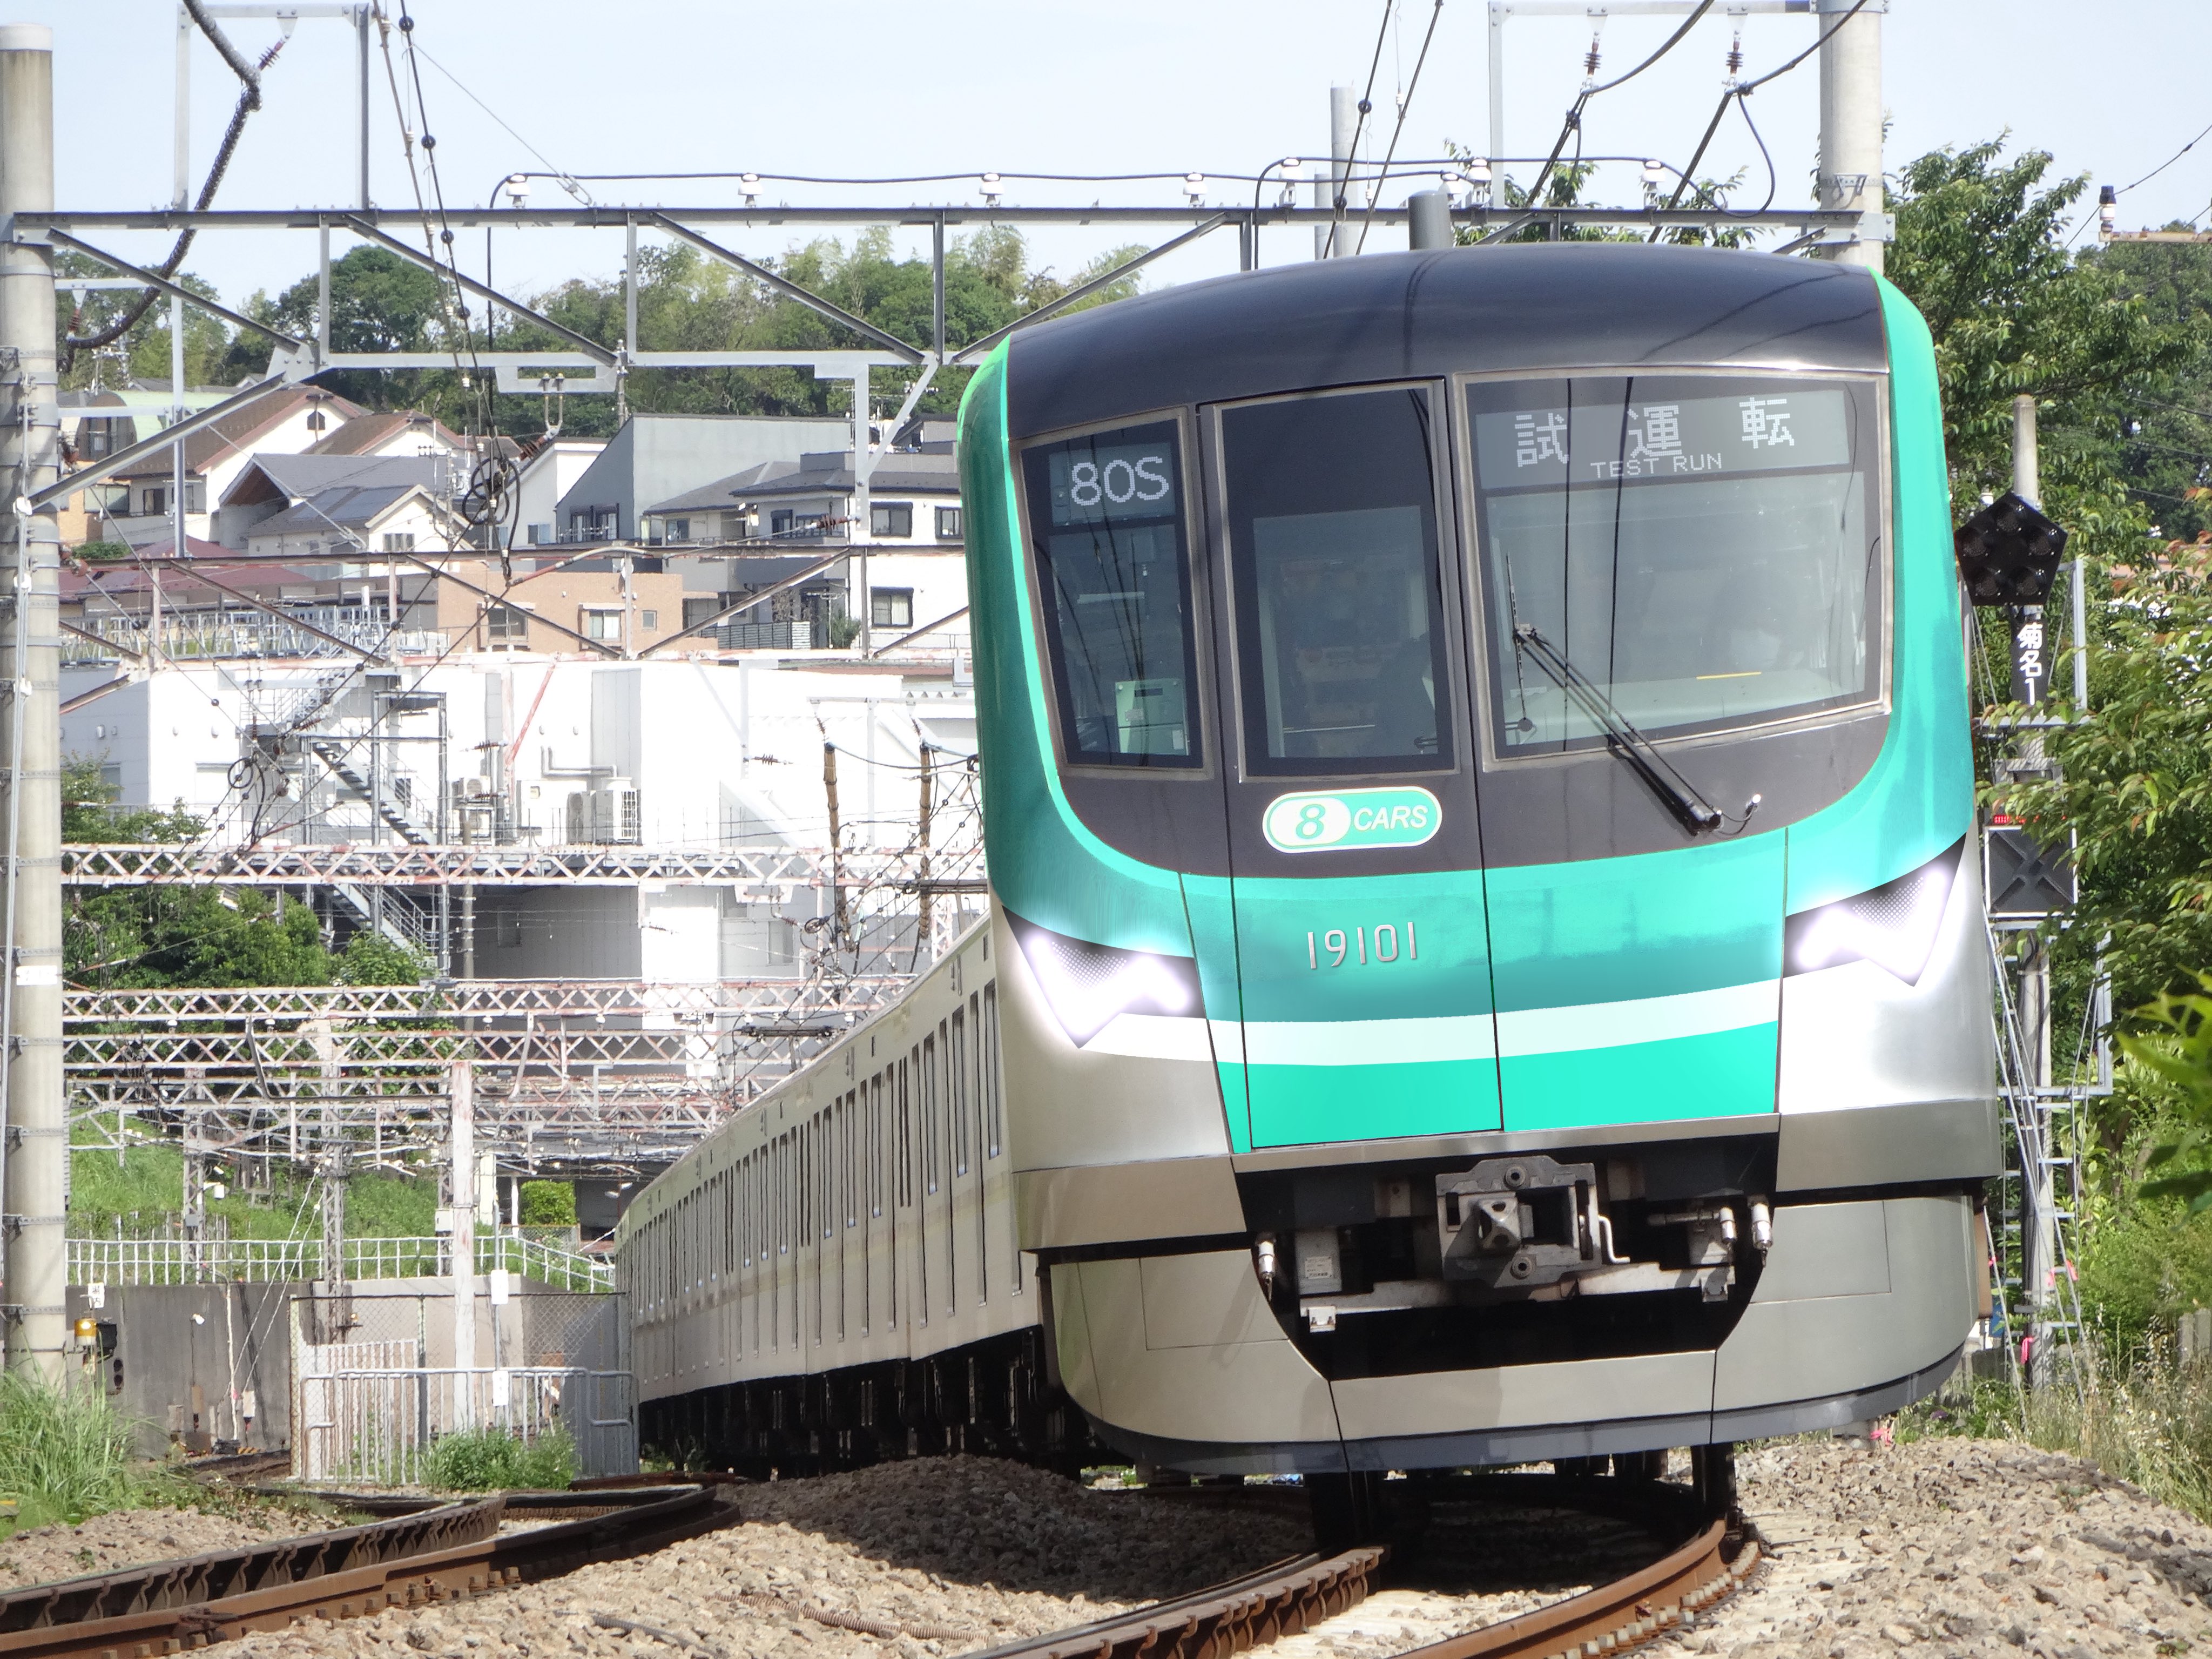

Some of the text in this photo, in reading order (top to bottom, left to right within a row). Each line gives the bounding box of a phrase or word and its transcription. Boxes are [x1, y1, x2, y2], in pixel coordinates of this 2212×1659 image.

[1514, 397, 1795, 467] 試運転
[1070, 456, 1170, 505] 80S
[1590, 453, 1722, 478] TEST RUN
[2018, 622, 2043, 705] 菊名1
[1296, 804, 1428, 839] 8 CARS
[1307, 921, 1417, 970] 19101
